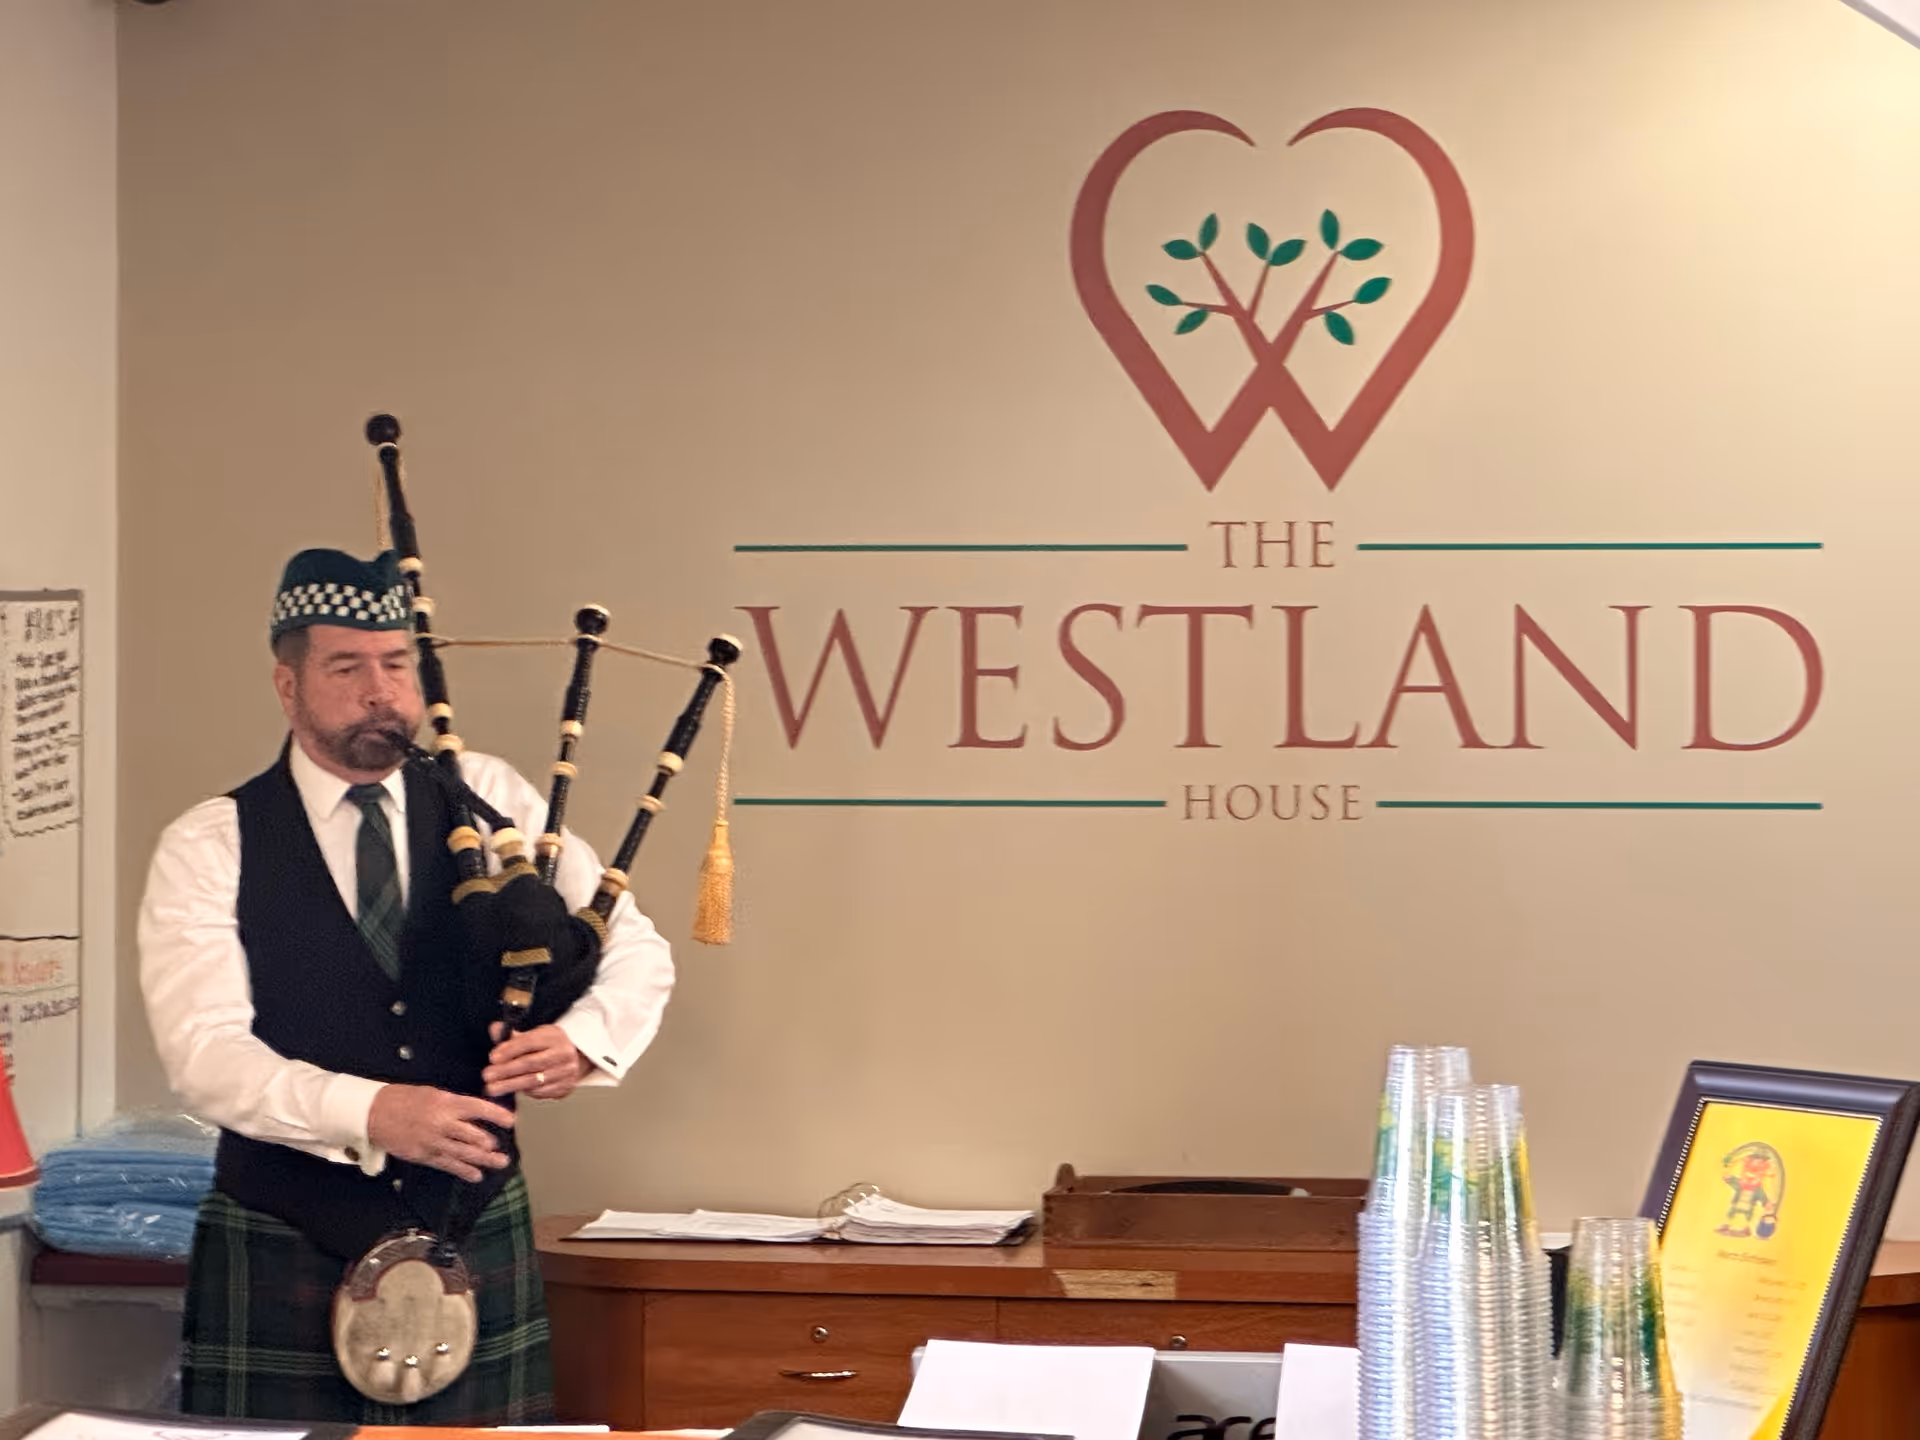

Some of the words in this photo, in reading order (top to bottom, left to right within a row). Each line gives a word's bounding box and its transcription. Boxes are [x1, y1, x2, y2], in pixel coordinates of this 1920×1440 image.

[1207, 520, 1336, 569] THE
[734, 602, 1825, 752] WESTLAND
[1181, 783, 1364, 821] HOUSE
